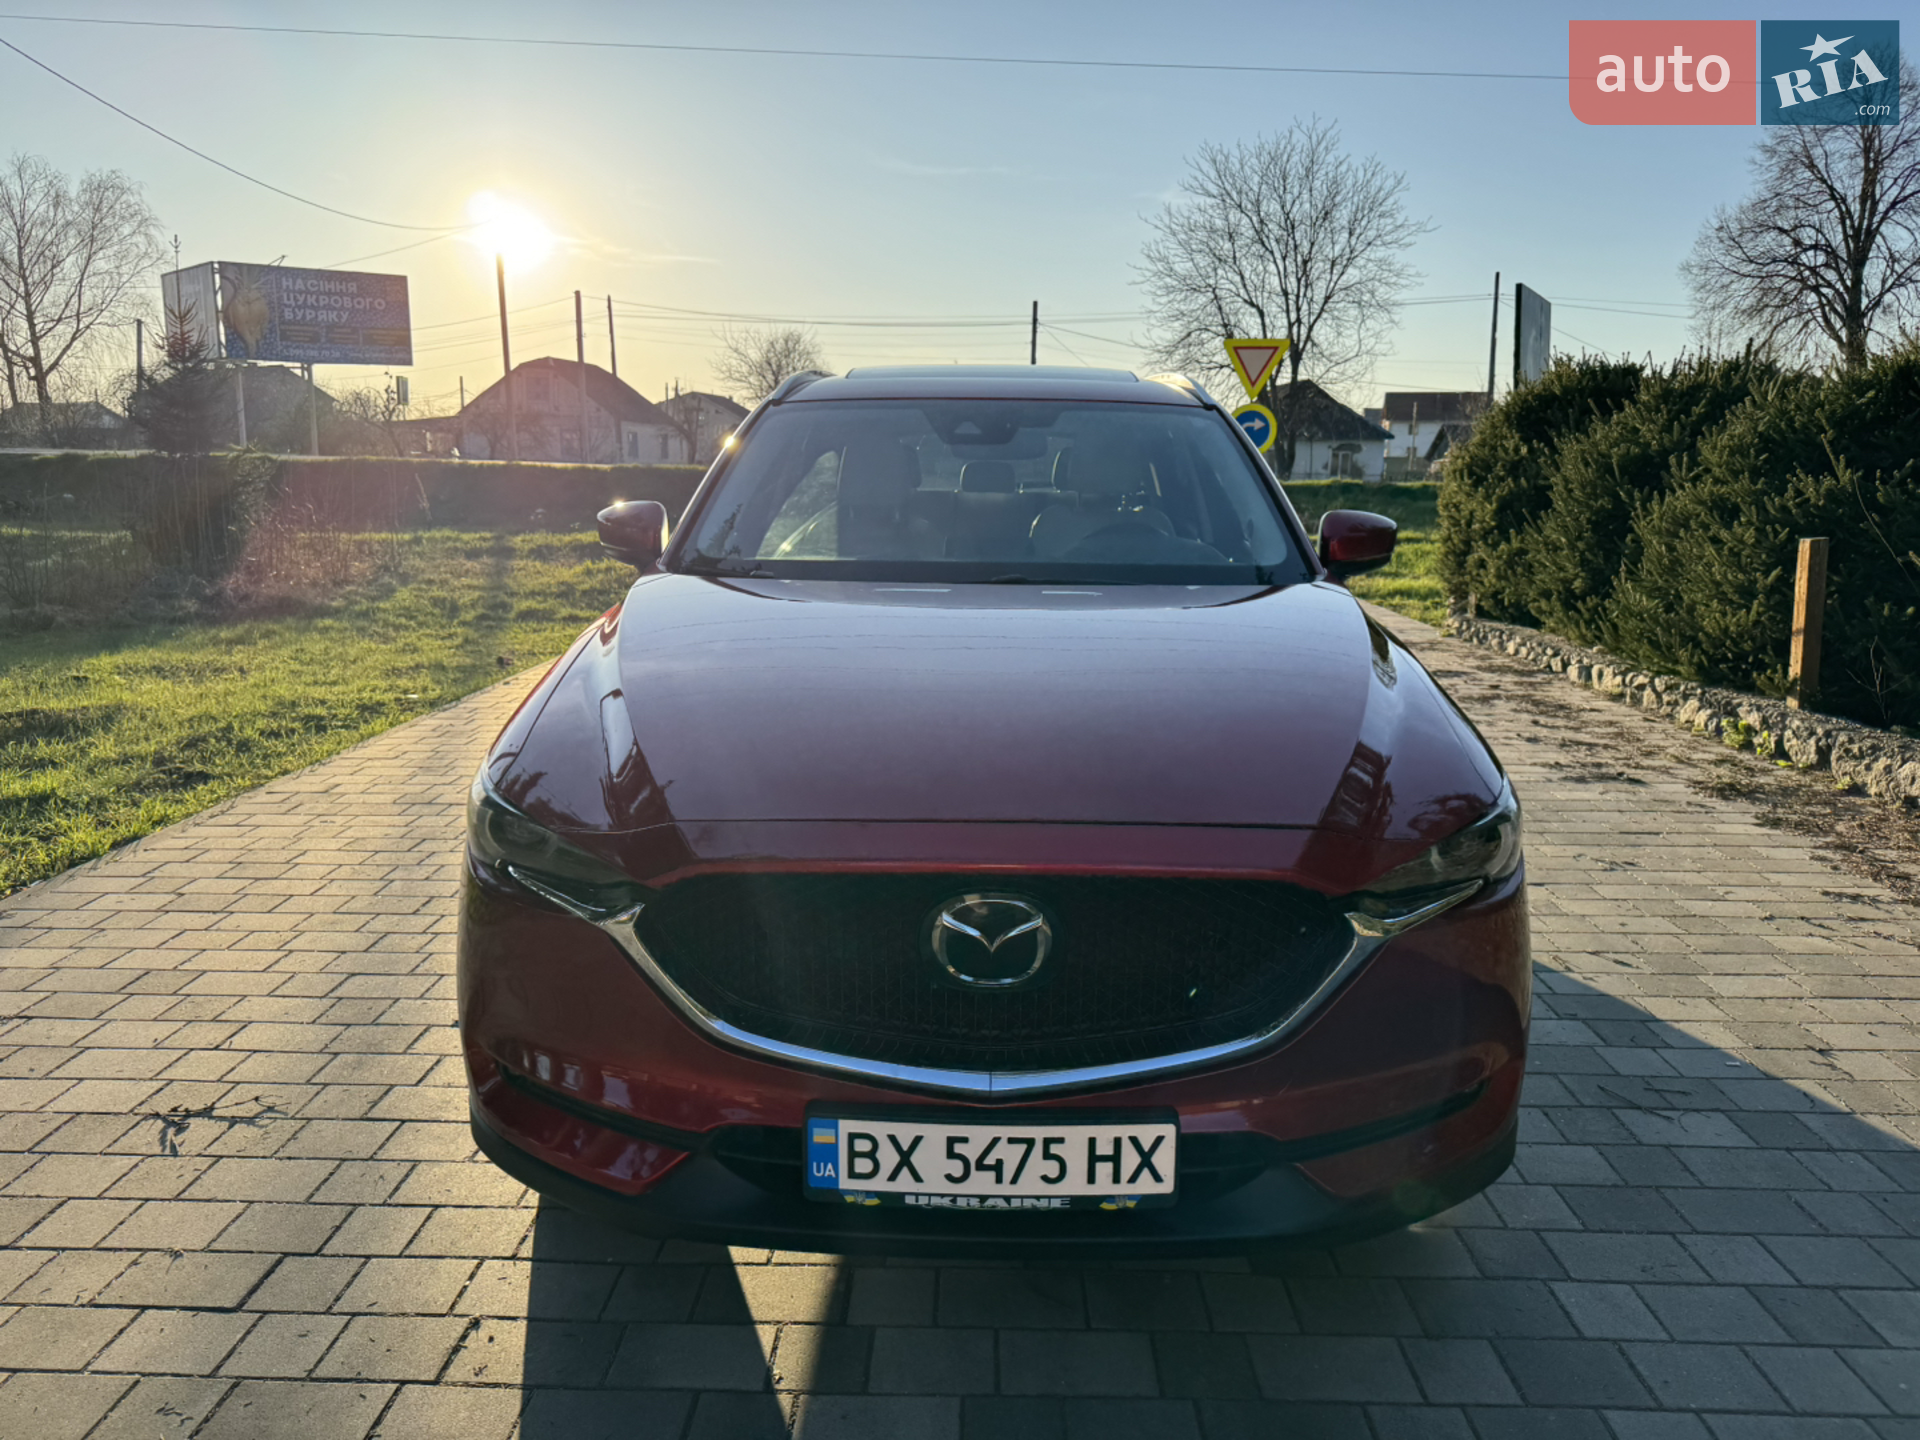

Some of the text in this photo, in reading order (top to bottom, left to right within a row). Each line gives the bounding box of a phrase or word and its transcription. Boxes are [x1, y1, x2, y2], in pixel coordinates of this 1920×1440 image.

[281, 277, 358, 294] НАСІННЯ
[283, 292, 387, 310] ЦУКРОВОГО
[284, 307, 350, 323] БУРЯКУ
[847, 1131, 1166, 1185] BX 5475 HX
[812, 1161, 836, 1178] UA
[904, 1195, 1071, 1209] UKRAINE
